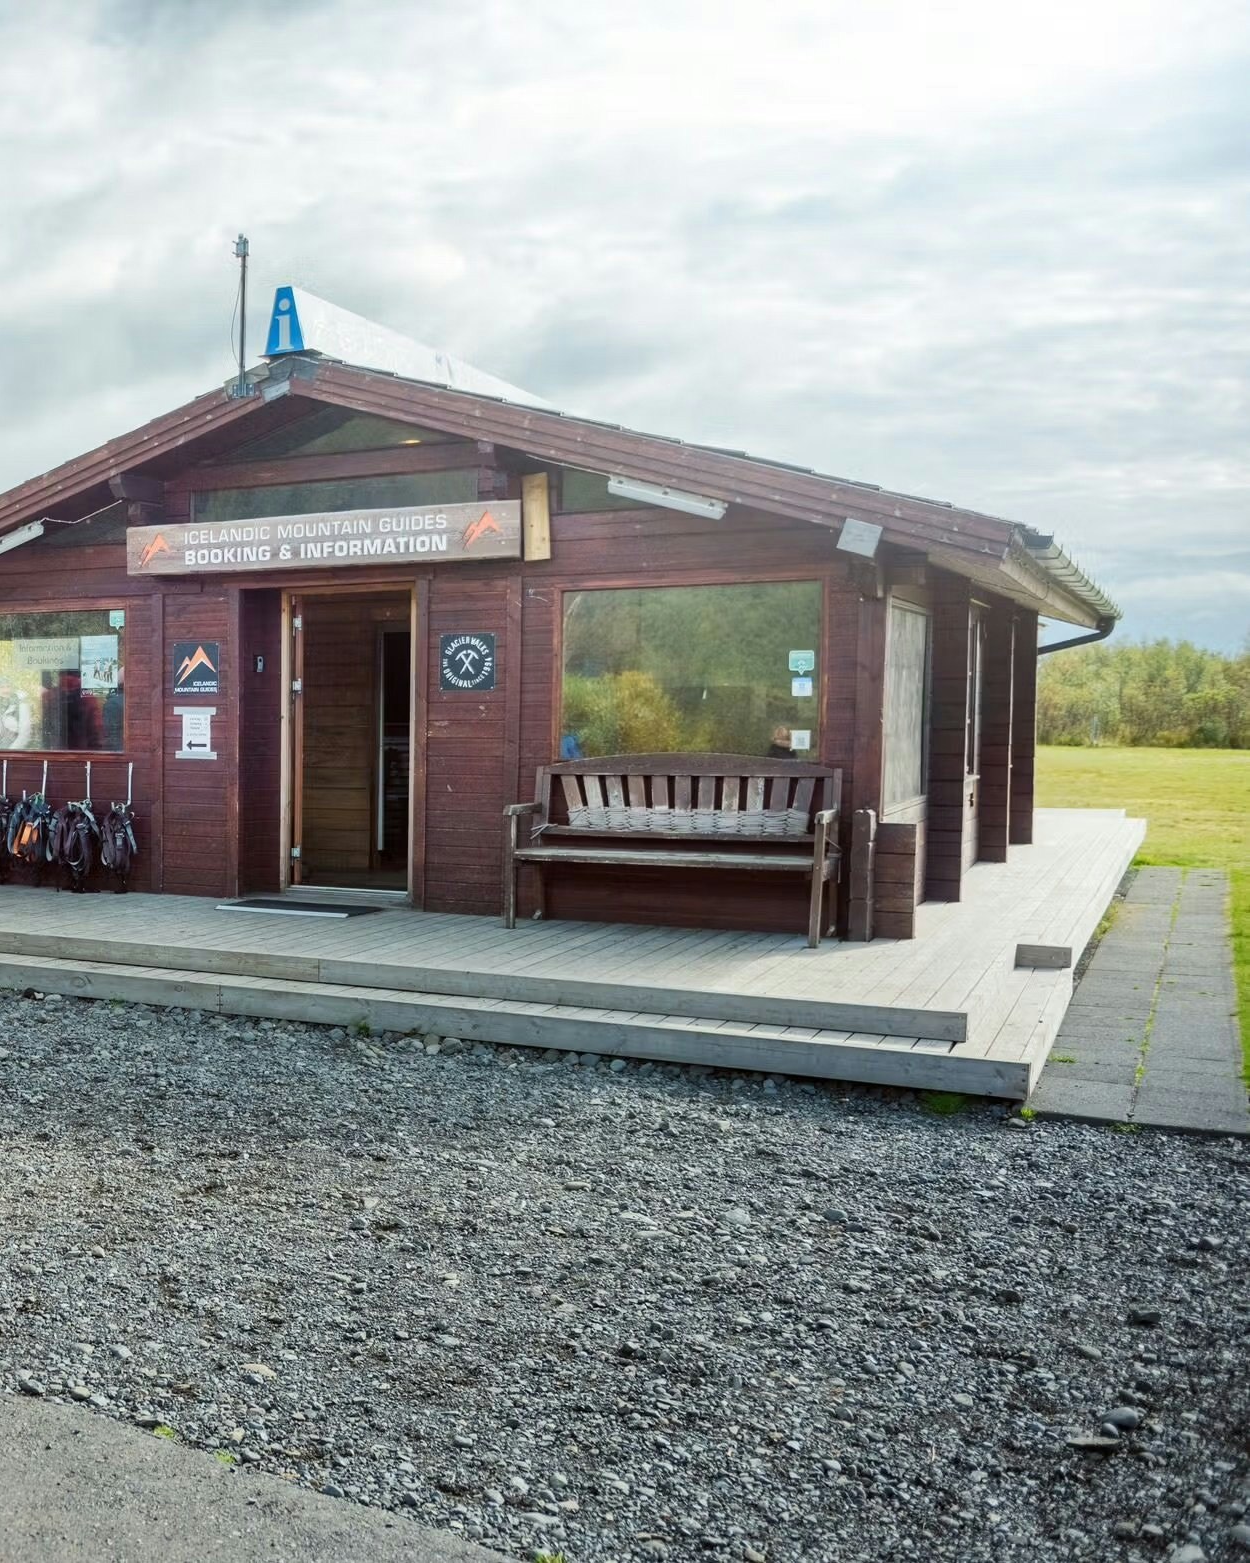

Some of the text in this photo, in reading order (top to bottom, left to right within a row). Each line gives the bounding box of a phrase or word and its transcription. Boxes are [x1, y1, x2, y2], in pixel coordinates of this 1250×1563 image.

[275, 298, 294, 351] i
[184, 514, 447, 545] ICELANDIC MOUNTAIN GUIDES
[185, 534, 447, 565] BOOKING & INFORMATION
[445, 636, 490, 655] GLACIER WALKS
[443, 668, 473, 688] ORIGINAL
